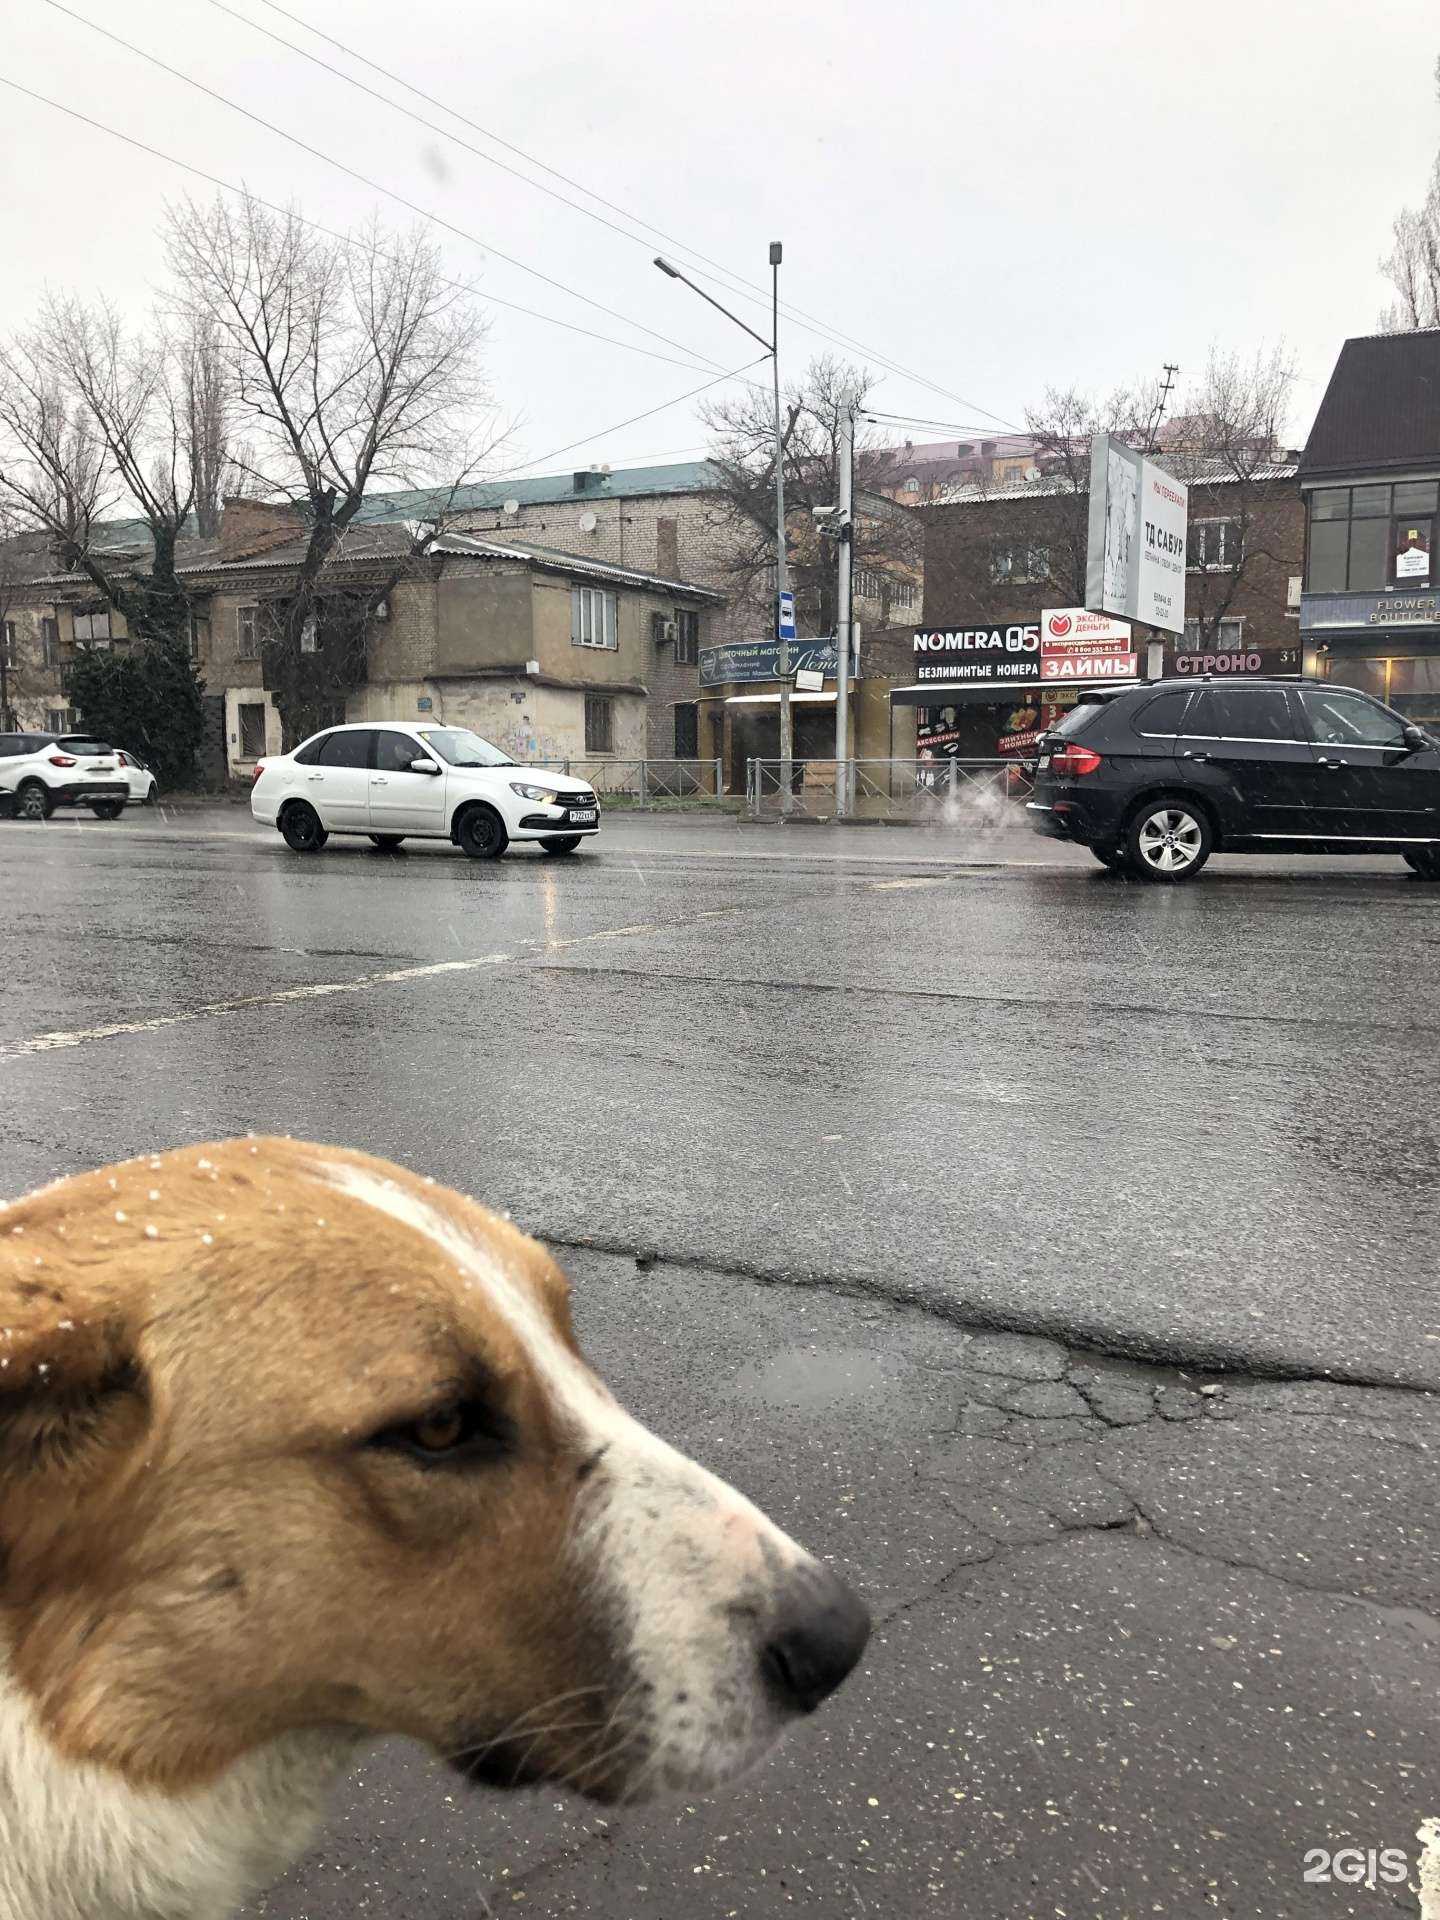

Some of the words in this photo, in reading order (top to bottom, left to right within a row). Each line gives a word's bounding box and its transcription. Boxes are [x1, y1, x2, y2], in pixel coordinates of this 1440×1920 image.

[1145, 521, 1156, 549] ТД
[1157, 525, 1183, 558] САБУР
[1377, 599, 1436, 610] FLOWER
[1076, 623, 1110, 632] ДЕНЬГИ
[997, 664, 1038, 676] НОМЕРА
[1046, 656, 1136, 677] ЗАЙМЫ
[1176, 654, 1261, 673] СТРОНО
